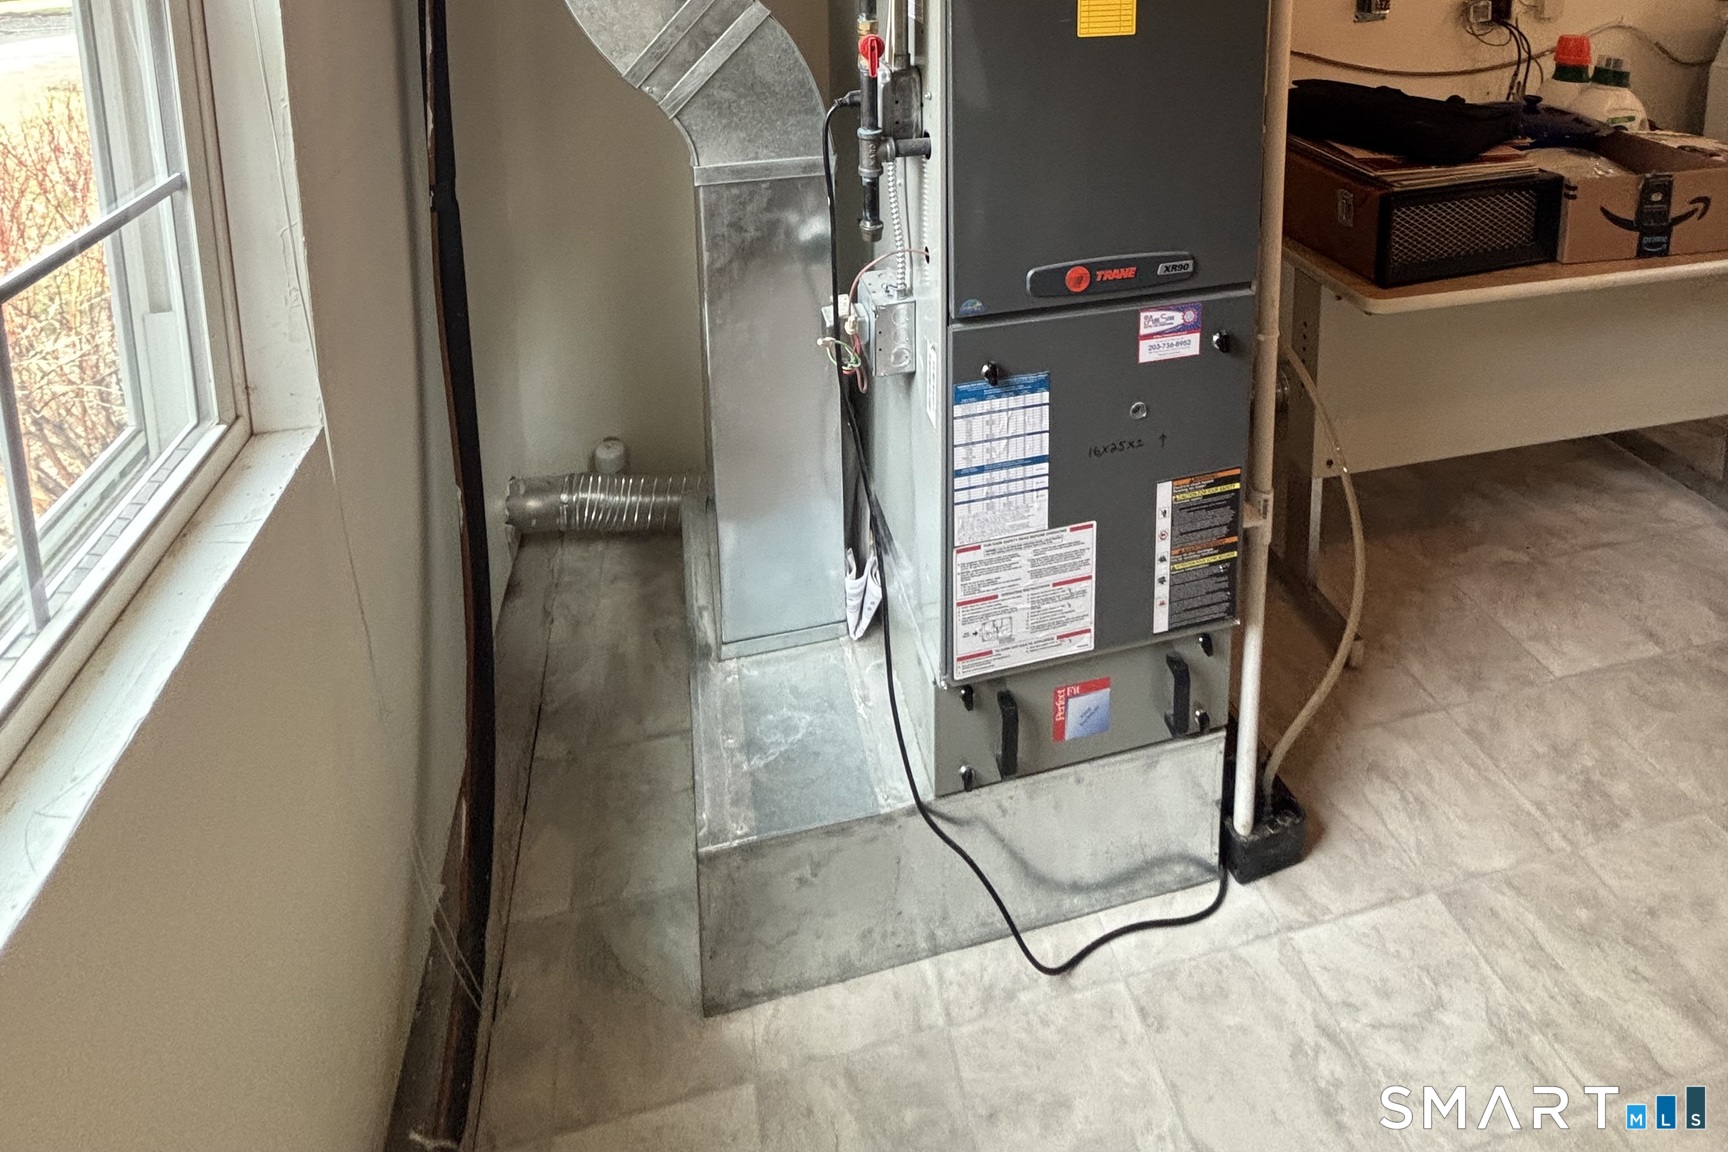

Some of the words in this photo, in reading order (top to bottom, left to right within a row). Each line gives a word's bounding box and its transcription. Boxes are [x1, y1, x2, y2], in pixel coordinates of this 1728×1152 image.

[1095, 267, 1137, 282] TRANE
[1163, 263, 1190, 274] XR90
[1055, 688, 1066, 721] Perfect
